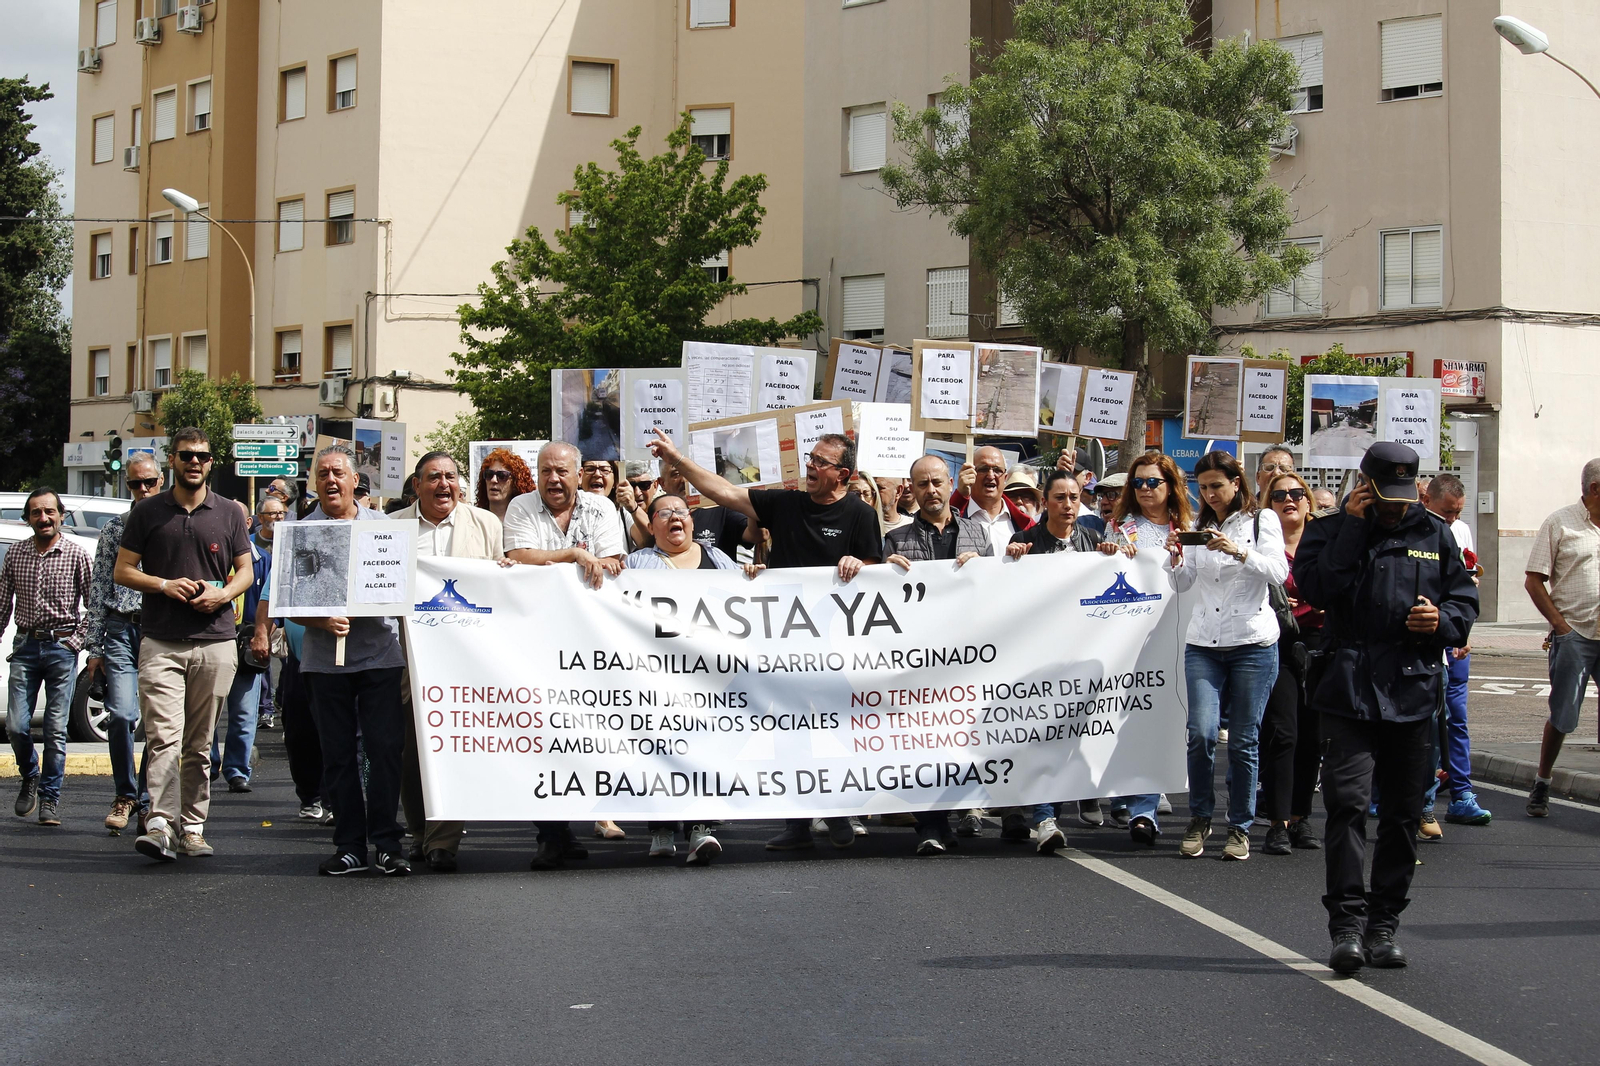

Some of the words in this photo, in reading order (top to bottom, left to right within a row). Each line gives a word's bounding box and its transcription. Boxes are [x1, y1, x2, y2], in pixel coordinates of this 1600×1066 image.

[841, 368, 871, 376] FACEBOOK
[1443, 362, 1484, 372] SHAWARMA
[841, 386, 866, 394] ALCALDE
[1090, 397, 1123, 405] FACEBOOK
[1172, 449, 1200, 458] LEBARA
[1408, 550, 1440, 560] POLICIA
[1132, 594, 1160, 602] Vecinos
[1086, 606, 1110, 619] La
[412, 613, 438, 626] La
[559, 650, 586, 670] LA
[594, 650, 709, 674] BAJADILLA
[716, 654, 749, 674] UN
[758, 653, 844, 673] BARRIO
[853, 644, 997, 671] MARGINADO
[851, 691, 882, 708] NO
[888, 685, 976, 706] TENEMOS
[982, 681, 1054, 702] HOGAR
[1058, 678, 1082, 696] DE
[1088, 670, 1166, 694] MAYORES
[450, 686, 542, 704] TENEMOS
[548, 689, 633, 708] PARQUES
[639, 690, 657, 706] NI
[664, 692, 748, 708] JARDINES
[851, 713, 880, 730] NO
[886, 708, 976, 728] TENEMOS
[982, 704, 1050, 724] ZONAS
[1054, 695, 1152, 719] DEPORTIVAS
[450, 711, 543, 728] TENEMOS
[549, 712, 624, 730] CENTRO
[631, 714, 654, 732] DE
[659, 714, 745, 732] ASUNTOS
[750, 712, 839, 731] SOCIALES
[854, 736, 884, 752] NO
[890, 730, 980, 750] TENEMOS
[986, 727, 1041, 746] NADA
[1045, 725, 1065, 742] DE
[1068, 720, 1115, 738] NADA
[450, 736, 543, 753] TENEMOS
[549, 737, 688, 755] AMBULATORIO
[534, 770, 586, 799] ¿LA
[596, 771, 750, 797] BAJADILLA
[757, 771, 786, 796] ES
[796, 769, 832, 795] DE
[840, 758, 1014, 793] ALGECIRAS?
